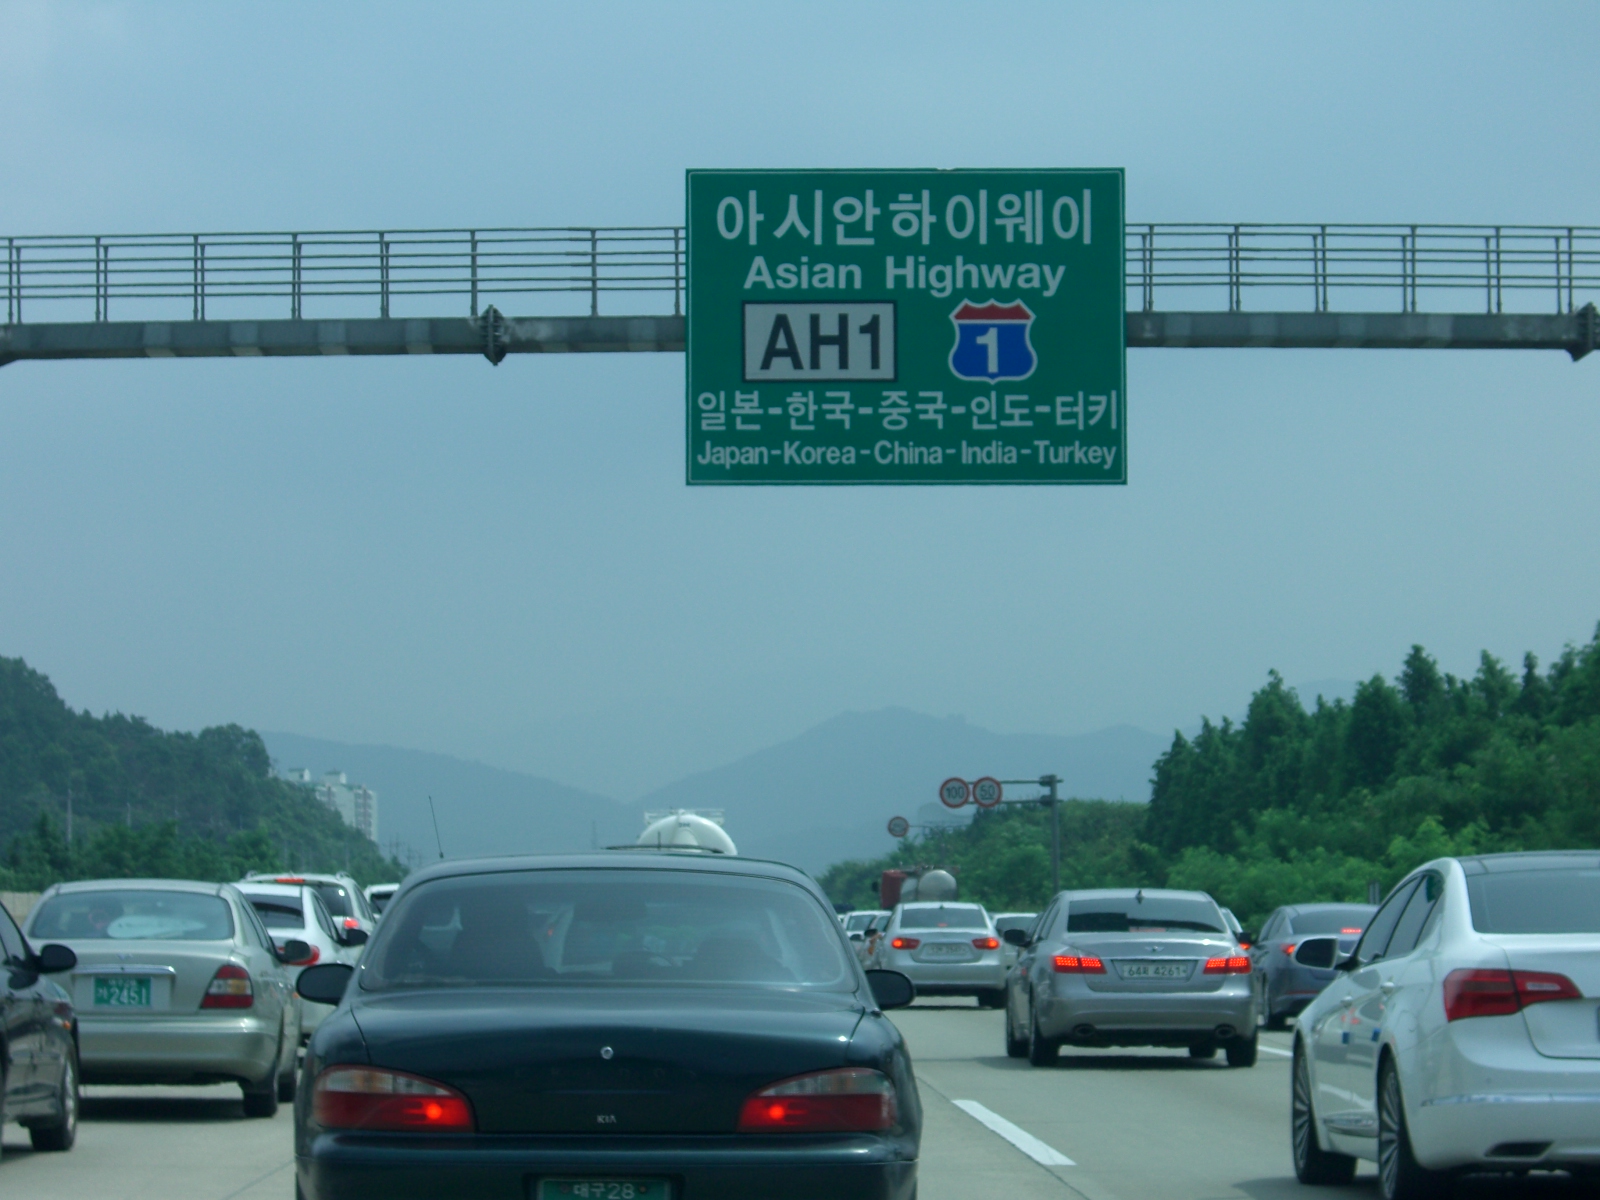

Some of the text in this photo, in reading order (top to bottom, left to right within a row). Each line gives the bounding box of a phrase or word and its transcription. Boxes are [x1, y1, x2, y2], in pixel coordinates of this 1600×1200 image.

[716, 188, 1092, 246] 아시안하이웨이
[743, 255, 1066, 297] Asian Highway
[759, 313, 881, 371] AH1
[976, 327, 999, 374] 1
[945, 786, 965, 799] 100
[980, 784, 996, 797] 50
[109, 986, 147, 1005] 2451
[596, 1114, 617, 1124] KIA
